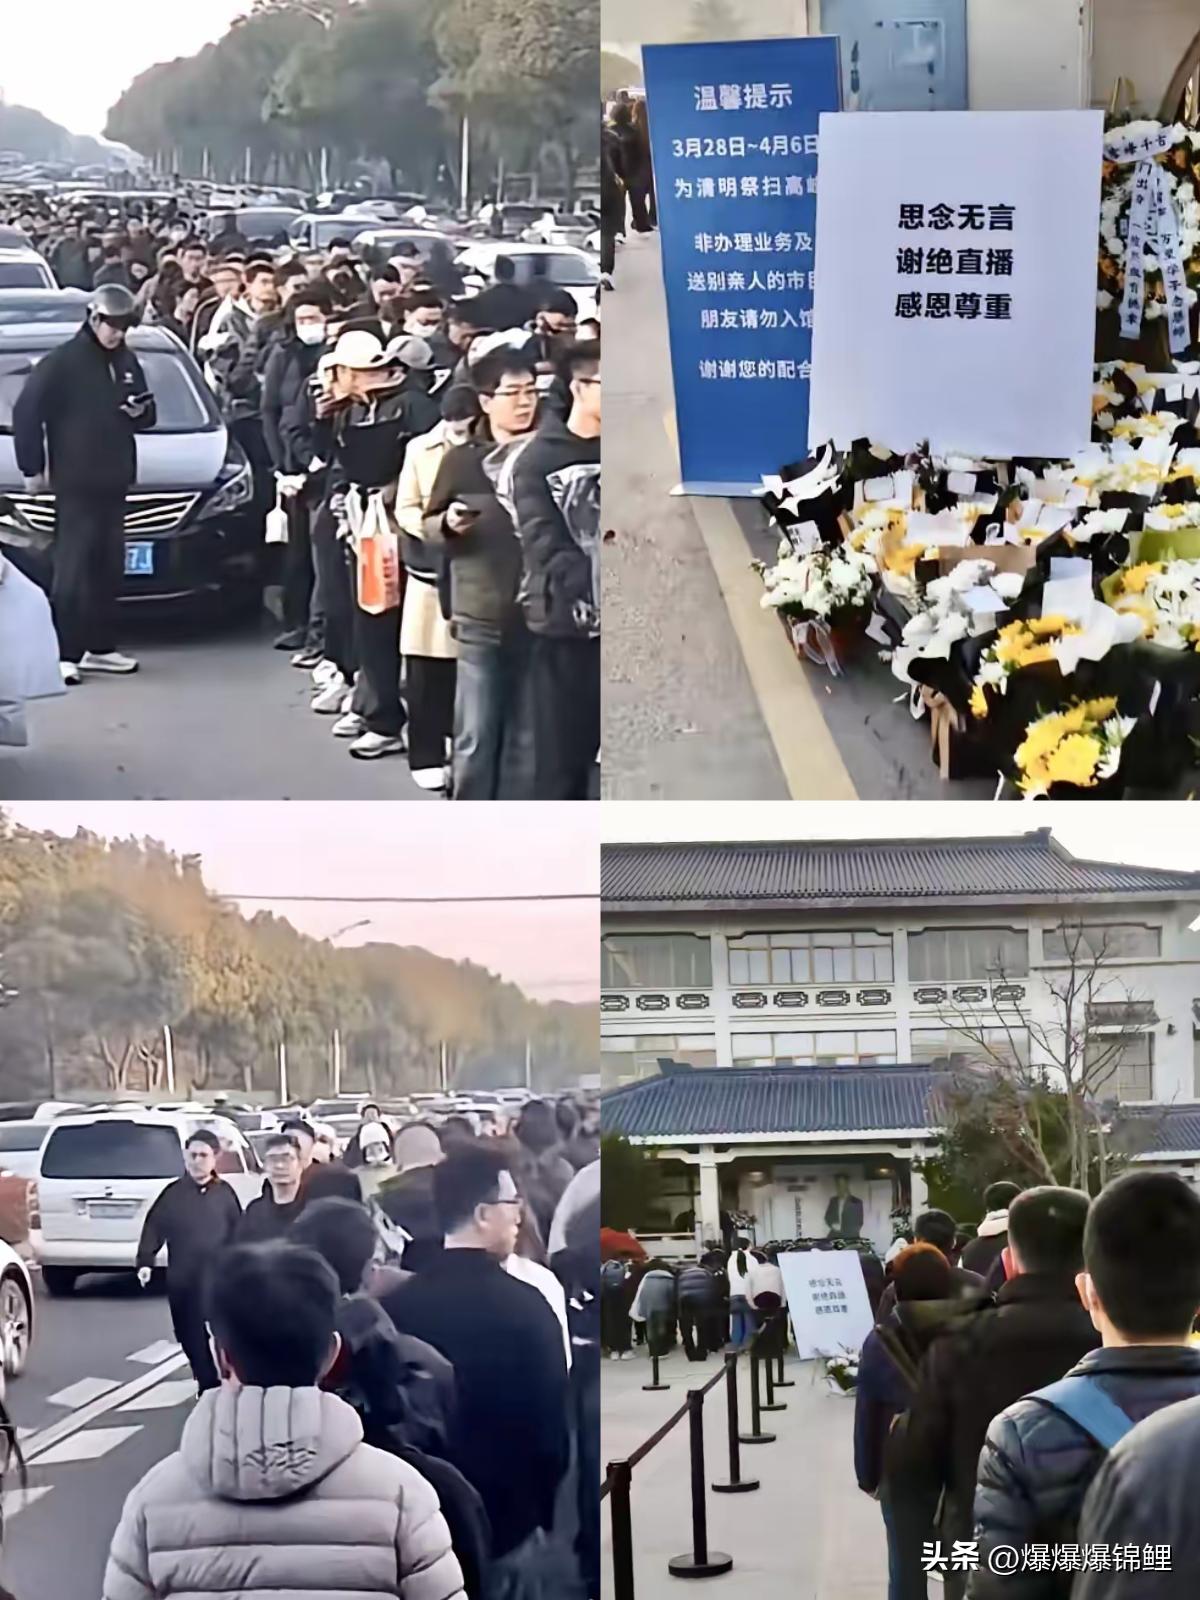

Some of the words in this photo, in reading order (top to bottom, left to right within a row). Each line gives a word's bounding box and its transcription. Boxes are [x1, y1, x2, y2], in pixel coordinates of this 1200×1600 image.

[693, 83, 793, 111] 温馨提示
[672, 134, 818, 158] 3月28日~4月6日
[898, 203, 1016, 231] 思念无言
[694, 231, 814, 254] 非办理业务及
[896, 247, 1014, 276] 谢绝直播
[895, 291, 1012, 320] 感恩尊重
[699, 359, 812, 380] 谢谢您的配合
